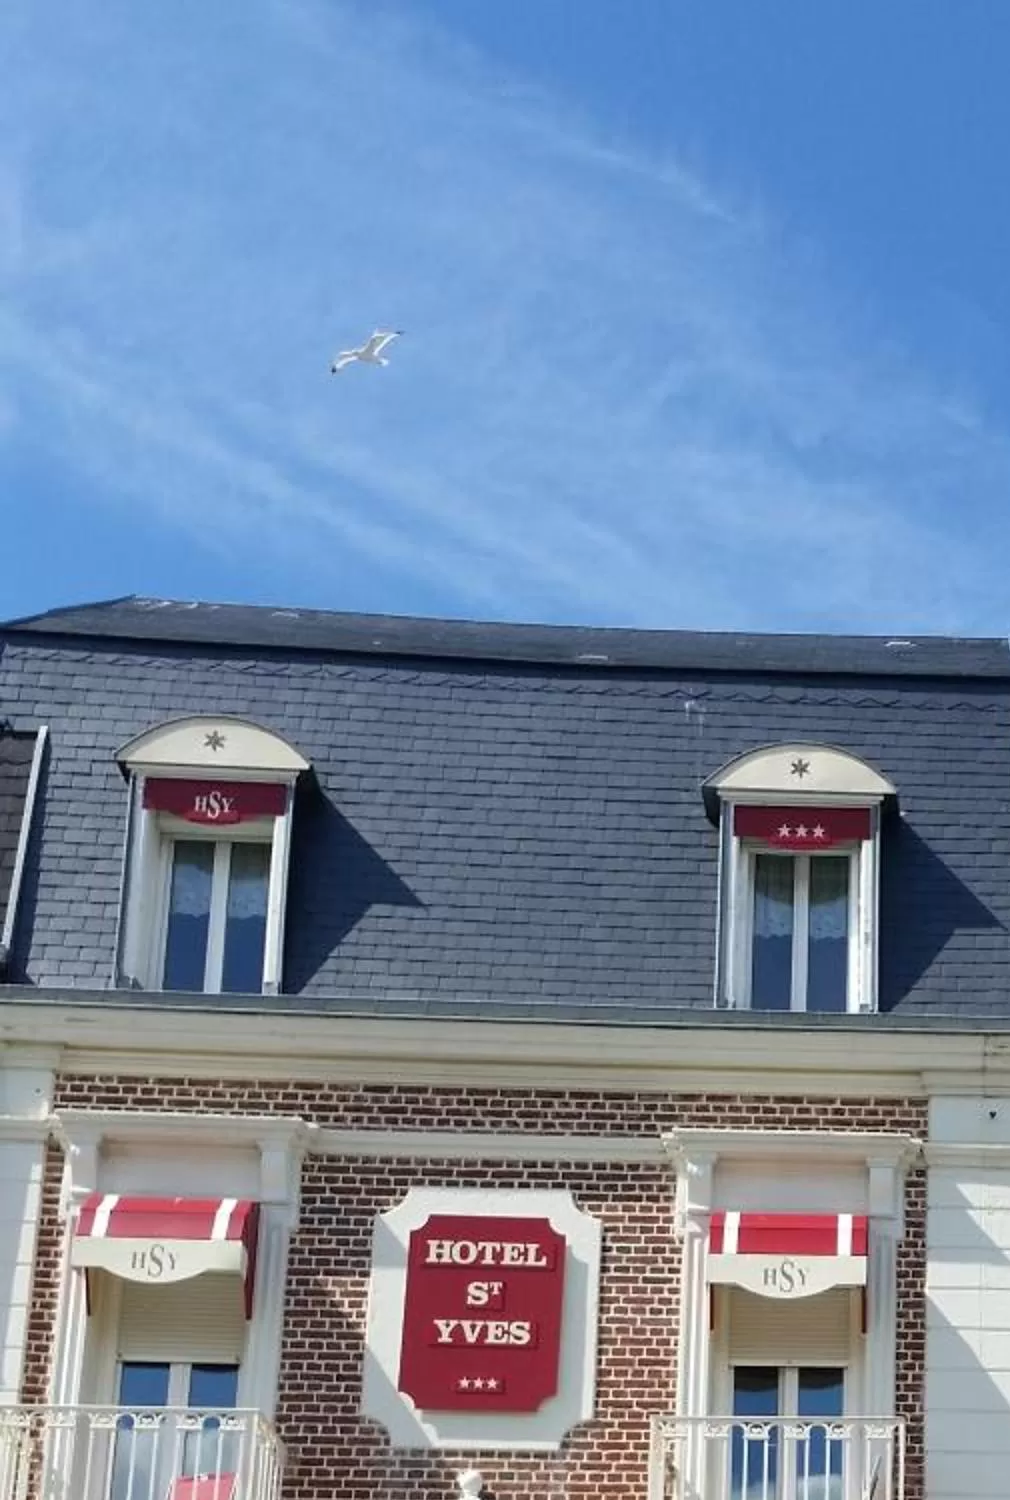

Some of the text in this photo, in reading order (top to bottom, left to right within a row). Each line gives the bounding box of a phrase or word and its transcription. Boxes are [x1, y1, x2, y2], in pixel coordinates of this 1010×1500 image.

[195, 791, 234, 819] HSY
[131, 1244, 177, 1277] HSY
[425, 1239, 547, 1267] HOTEL
[763, 1260, 810, 1292] HSY
[433, 1319, 531, 1345] YVES
